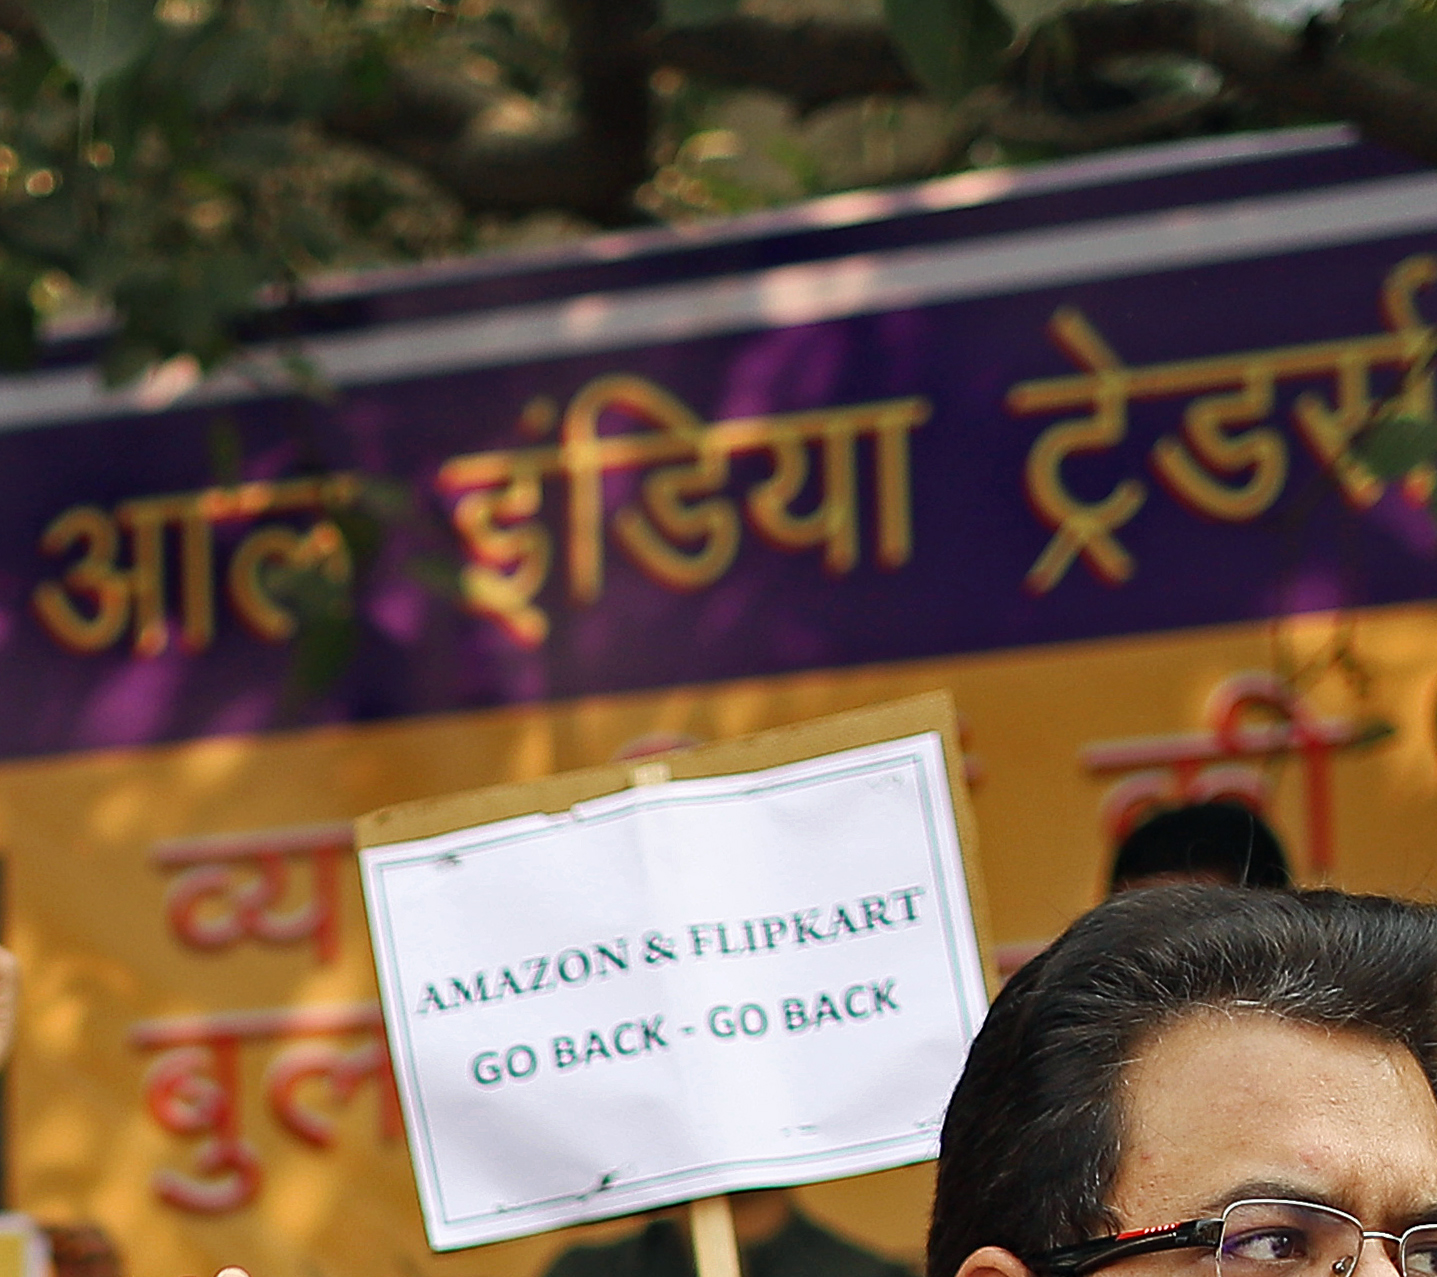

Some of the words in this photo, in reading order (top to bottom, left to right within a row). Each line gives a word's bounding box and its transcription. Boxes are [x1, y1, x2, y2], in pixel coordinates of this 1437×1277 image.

[438, 374, 930, 645] इंडिया
[415, 936, 630, 1014] AMAZON
[641, 930, 679, 969] &
[687, 886, 927, 957] FLIPKART
[472, 1043, 538, 1087] GO
[552, 1013, 668, 1070] BACK
[705, 1001, 768, 1040] GO
[782, 977, 901, 1033] BACK
